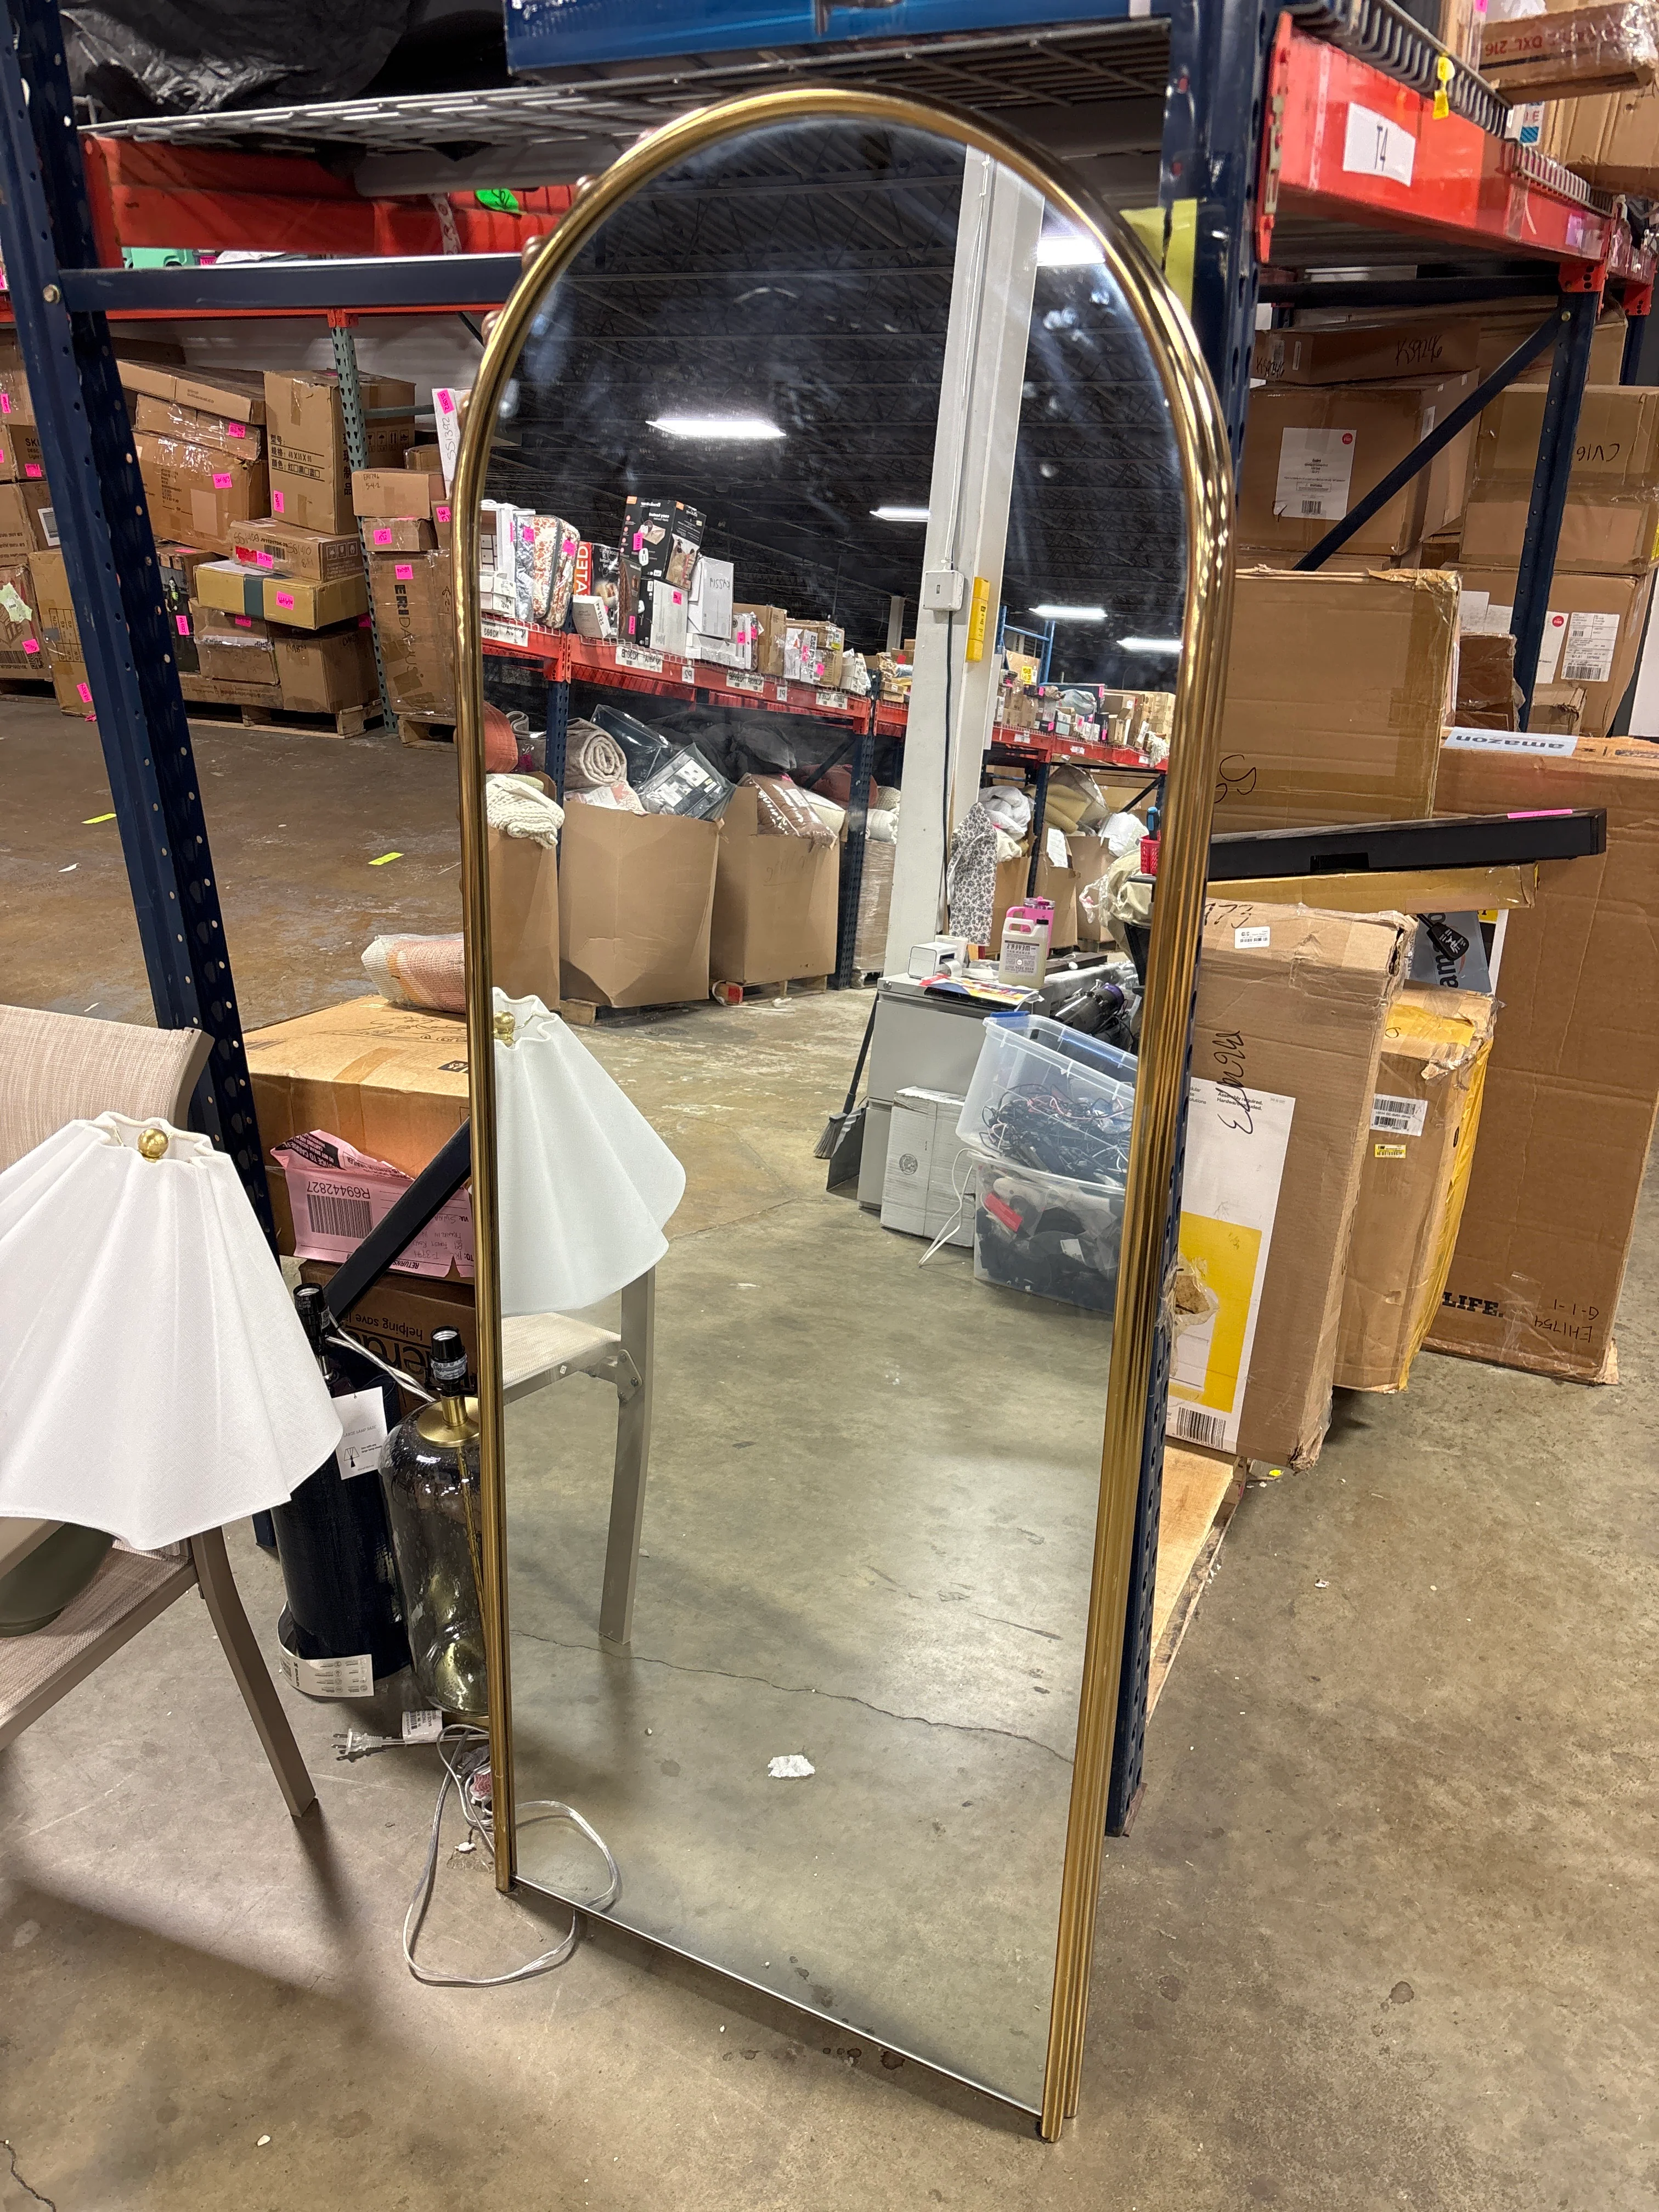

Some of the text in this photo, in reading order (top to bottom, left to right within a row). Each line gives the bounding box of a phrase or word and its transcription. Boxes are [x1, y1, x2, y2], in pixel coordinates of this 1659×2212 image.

[1456, 735, 1565, 749] amazon
[307, 1181, 370, 1199] R69442827
[1442, 1291, 1503, 1317] LIFE.
[356, 1313, 379, 1327] save
[382, 1318, 423, 1341] helping
